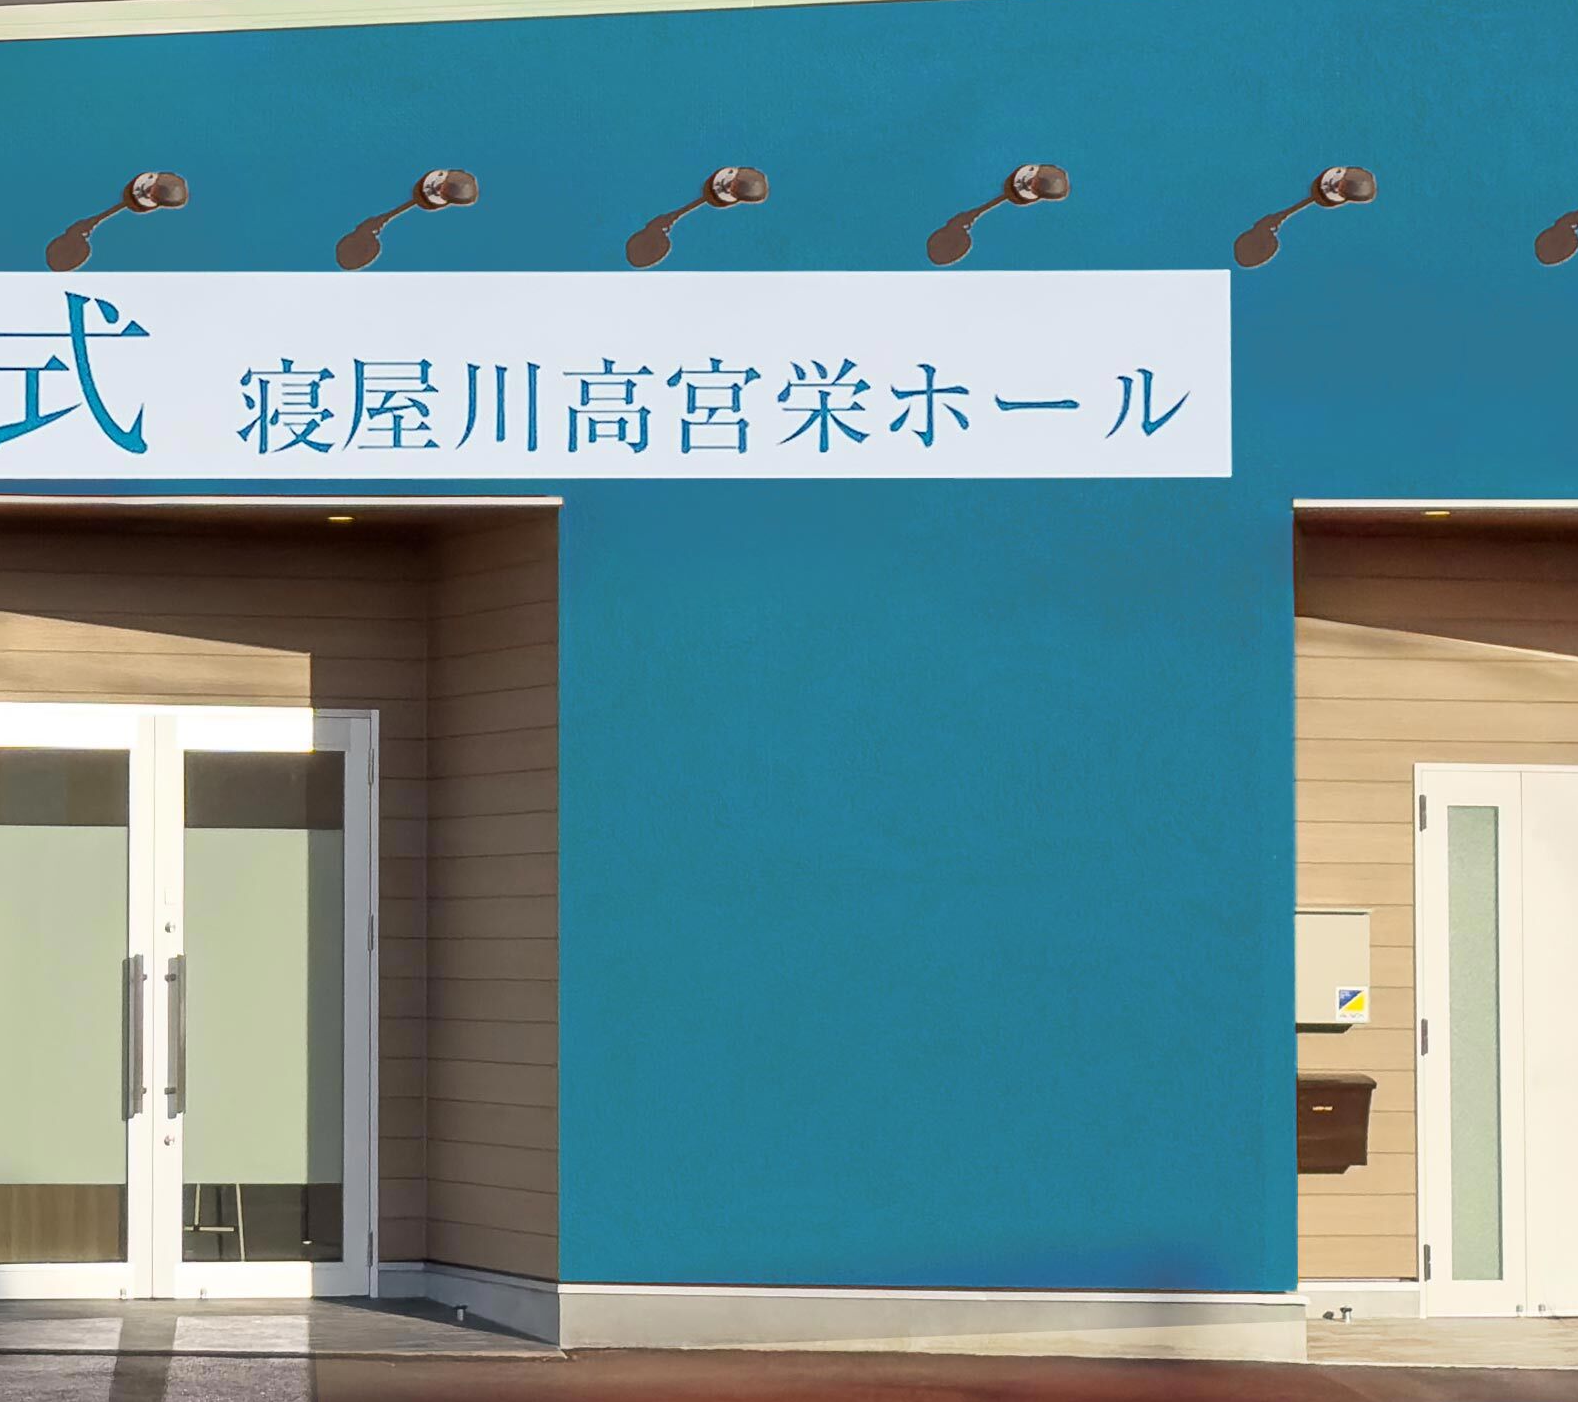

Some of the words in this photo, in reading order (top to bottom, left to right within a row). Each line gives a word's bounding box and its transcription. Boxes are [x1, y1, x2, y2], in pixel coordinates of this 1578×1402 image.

[235, 356, 1190, 456] 寝屋川高宮栄ホール
